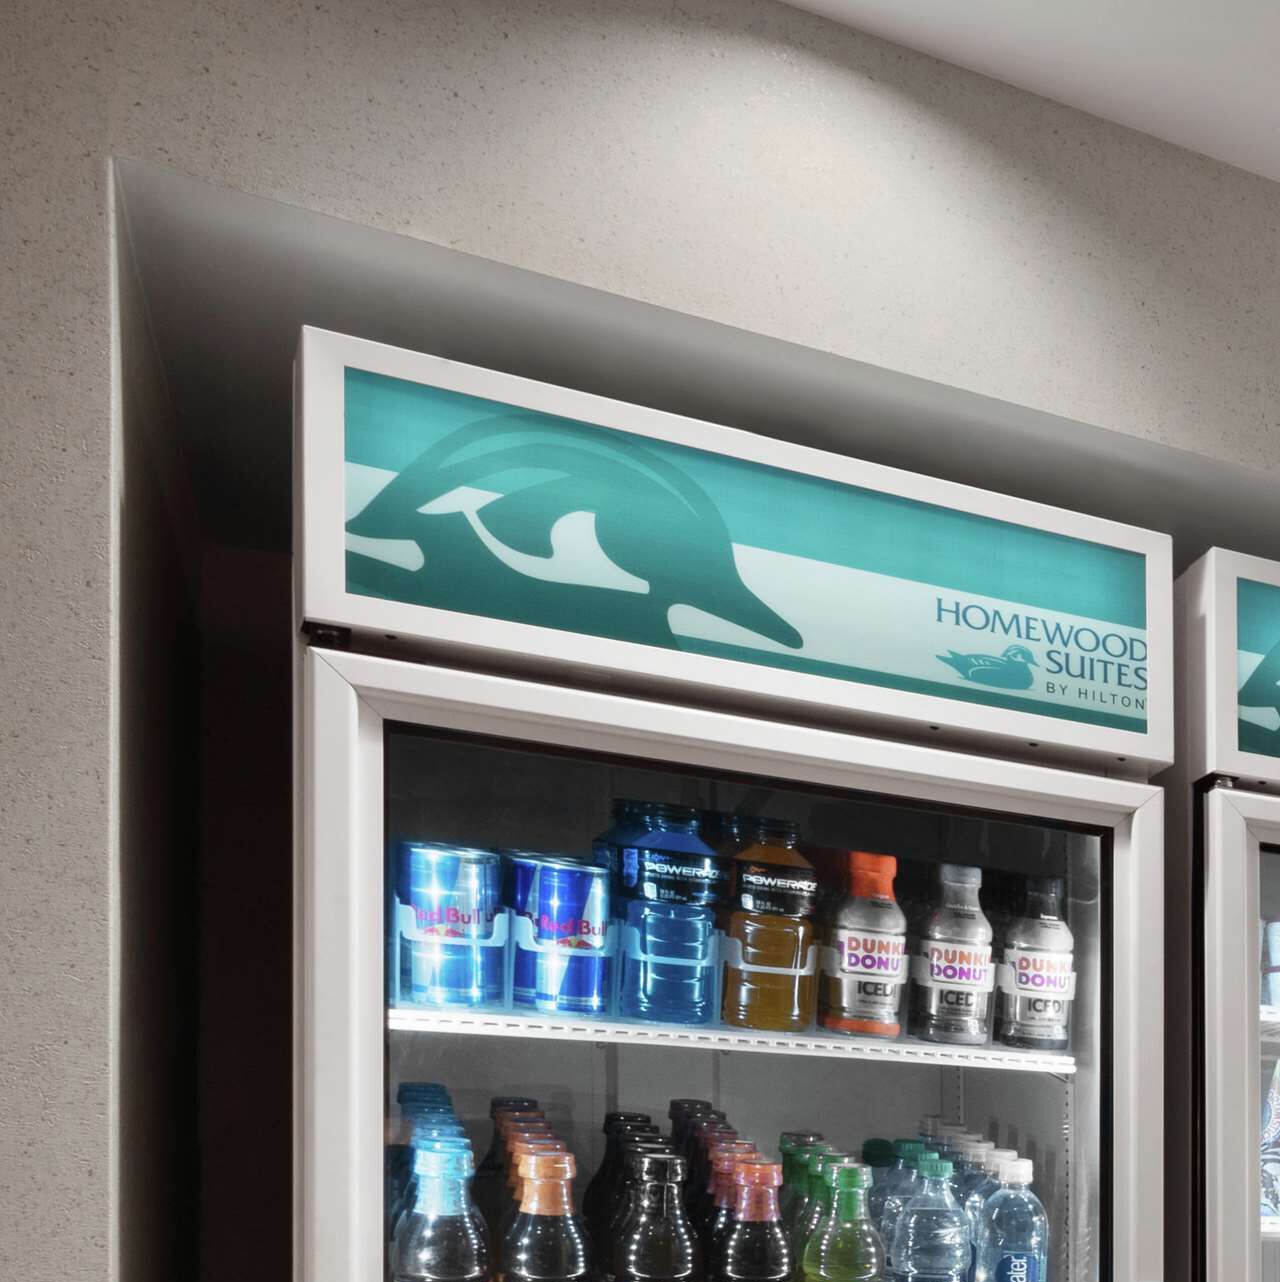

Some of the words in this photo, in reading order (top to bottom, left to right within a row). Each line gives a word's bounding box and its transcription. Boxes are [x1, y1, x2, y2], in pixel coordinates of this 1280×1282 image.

[936, 597, 1147, 662] HOMEWOOD
[1045, 650, 1147, 690] SUITES
[1046, 682, 1068, 696] BY
[1078, 687, 1145, 711] HILTON
[857, 981, 894, 997] ICED
[940, 990, 974, 1007] ICED
